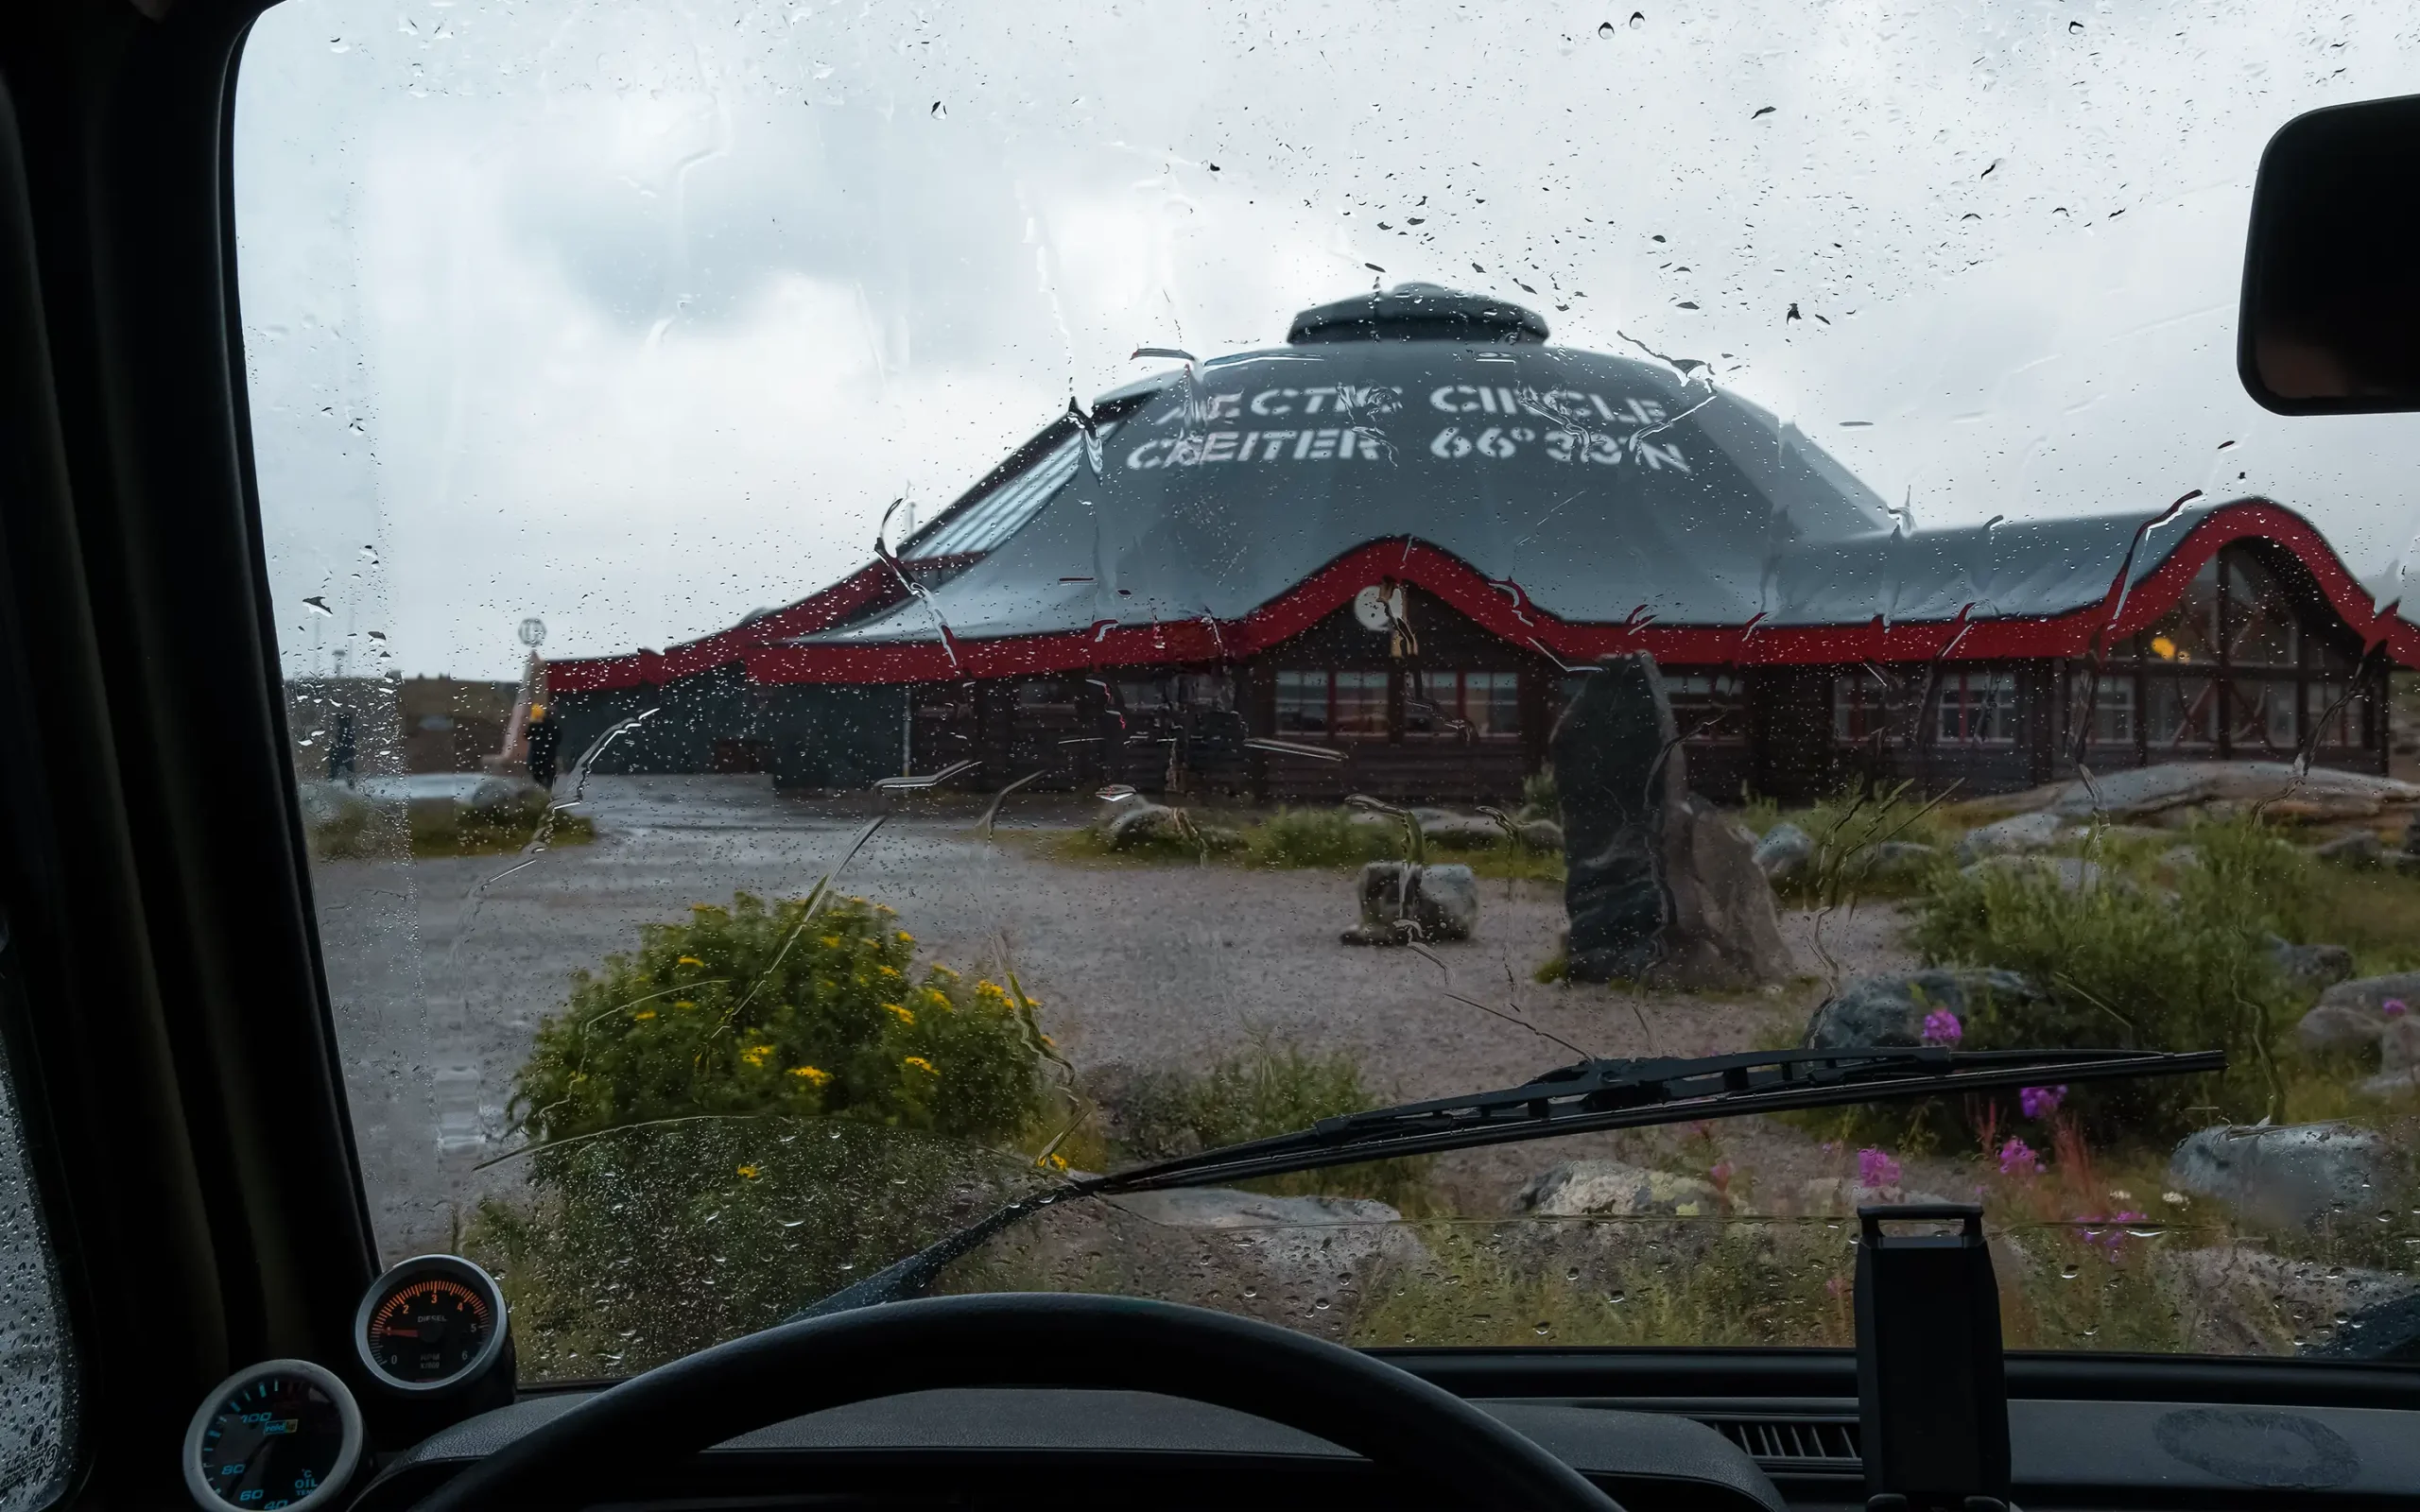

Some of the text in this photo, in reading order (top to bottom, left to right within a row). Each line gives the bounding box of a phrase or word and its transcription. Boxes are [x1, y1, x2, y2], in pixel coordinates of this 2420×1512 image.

[430, 1294, 438, 1304] 3
[402, 1304, 409, 1314] 2
[457, 1302, 464, 1313] 4
[417, 1314, 448, 1323] DIESEL
[470, 1324, 476, 1333] 5
[390, 1354, 398, 1365] 0
[461, 1350, 469, 1361] 6
[241, 1411, 273, 1423] 100
[221, 1464, 246, 1475] 80
[295, 1478, 319, 1488] OIL
[239, 1489, 265, 1502] 60
[264, 1499, 288, 1509] 40
